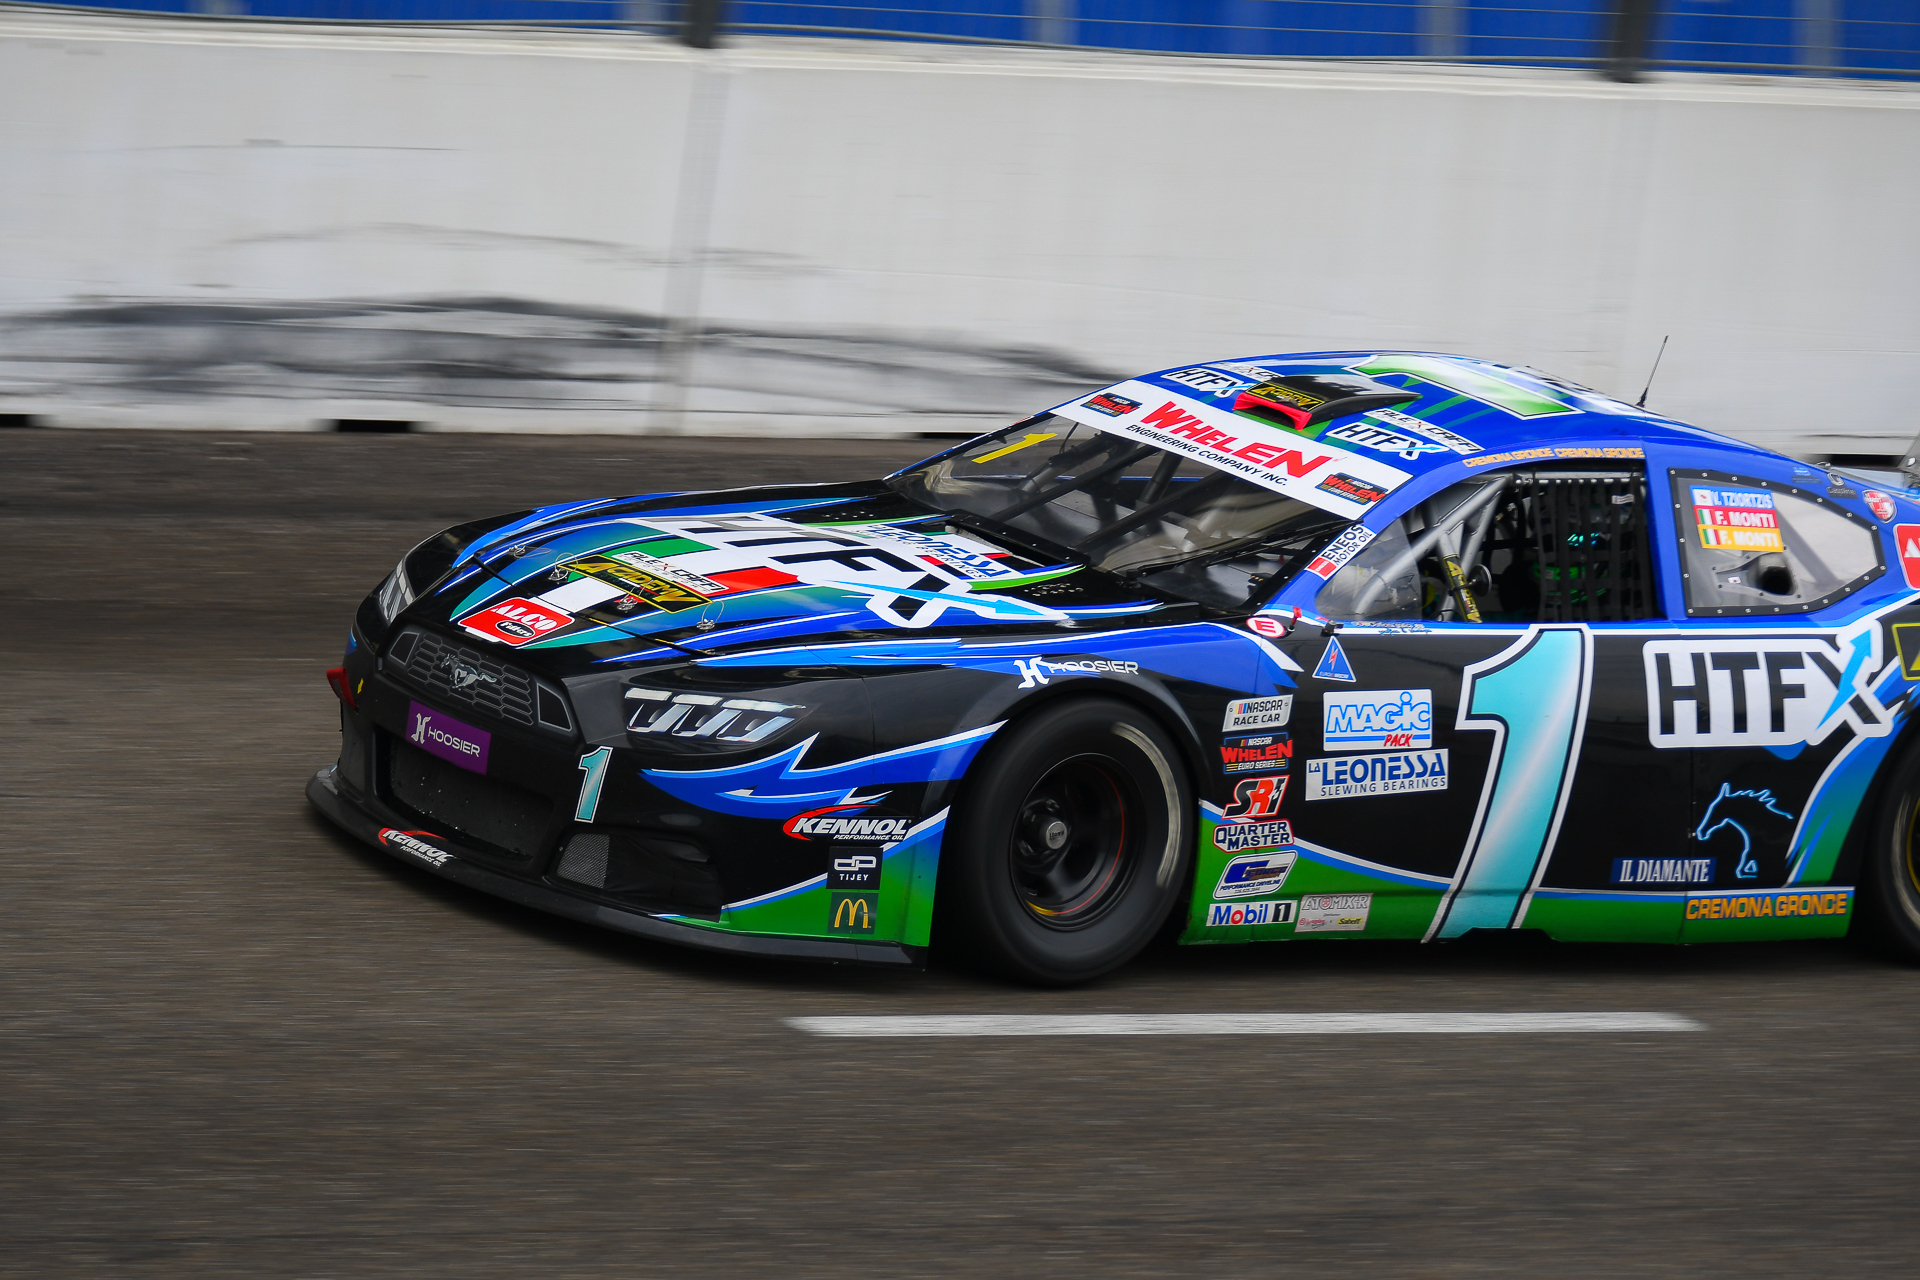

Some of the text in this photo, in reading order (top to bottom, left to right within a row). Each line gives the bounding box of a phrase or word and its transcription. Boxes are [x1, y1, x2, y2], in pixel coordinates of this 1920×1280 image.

[972, 432, 1058, 464] 1
[1140, 401, 1332, 478] WHELEN
[1333, 424, 1441, 457] HTFX
[1126, 424, 1287, 486] ENGINEERING COMPANY INC.
[1462, 452, 1512, 468] CREMONA
[1323, 475, 1386, 502] WHELEN
[1715, 511, 1775, 527] F. MONTI
[1321, 524, 1364, 561] ENEOS
[1334, 532, 1374, 566] MOTOR OIL
[1719, 530, 1779, 547] F. MONTI
[570, 562, 703, 602] ACADEMY
[490, 604, 557, 630] ALCO
[1047, 660, 1139, 675] HOOSIER
[1654, 630, 1882, 735] HTFX
[1233, 713, 1280, 726] RACE CAR
[1246, 699, 1283, 714] NASCAR
[427, 726, 481, 757] HOOSIER
[1220, 740, 1293, 763] WHELEN
[1383, 733, 1413, 747] PACK
[1308, 752, 1446, 786] LA LEONESSA
[574, 746, 612, 823] 1
[1321, 777, 1446, 797] SLEWING BEARINGS
[791, 818, 908, 834] KENNOL
[1215, 822, 1287, 845] QUARTER
[382, 830, 454, 862] KENNOL
[1227, 833, 1290, 851] MASTER
[1619, 858, 1711, 882] IL DIAMANTE
[1212, 903, 1269, 925] Mobil
[1686, 893, 1847, 921] CREMONA GRONDE
